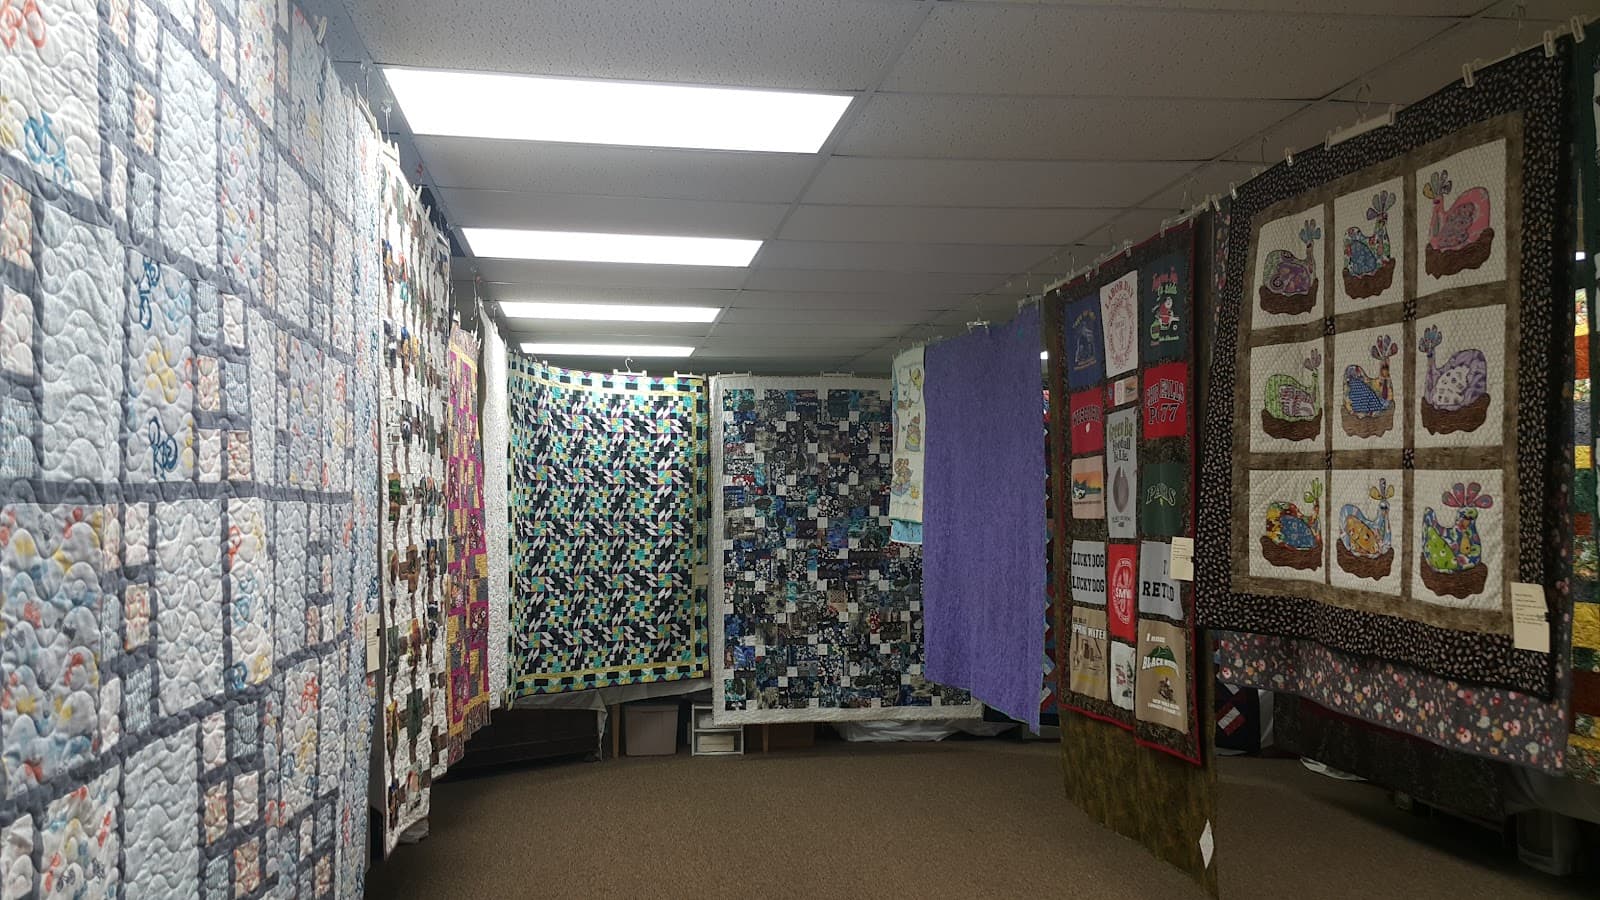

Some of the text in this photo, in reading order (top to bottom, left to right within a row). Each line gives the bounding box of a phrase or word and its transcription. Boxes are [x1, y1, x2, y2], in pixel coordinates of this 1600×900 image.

[1072, 552, 1092, 566] LUCKY
[1092, 554, 1105, 568] DOG
[1072, 576, 1105, 593] LUCKY DOG
